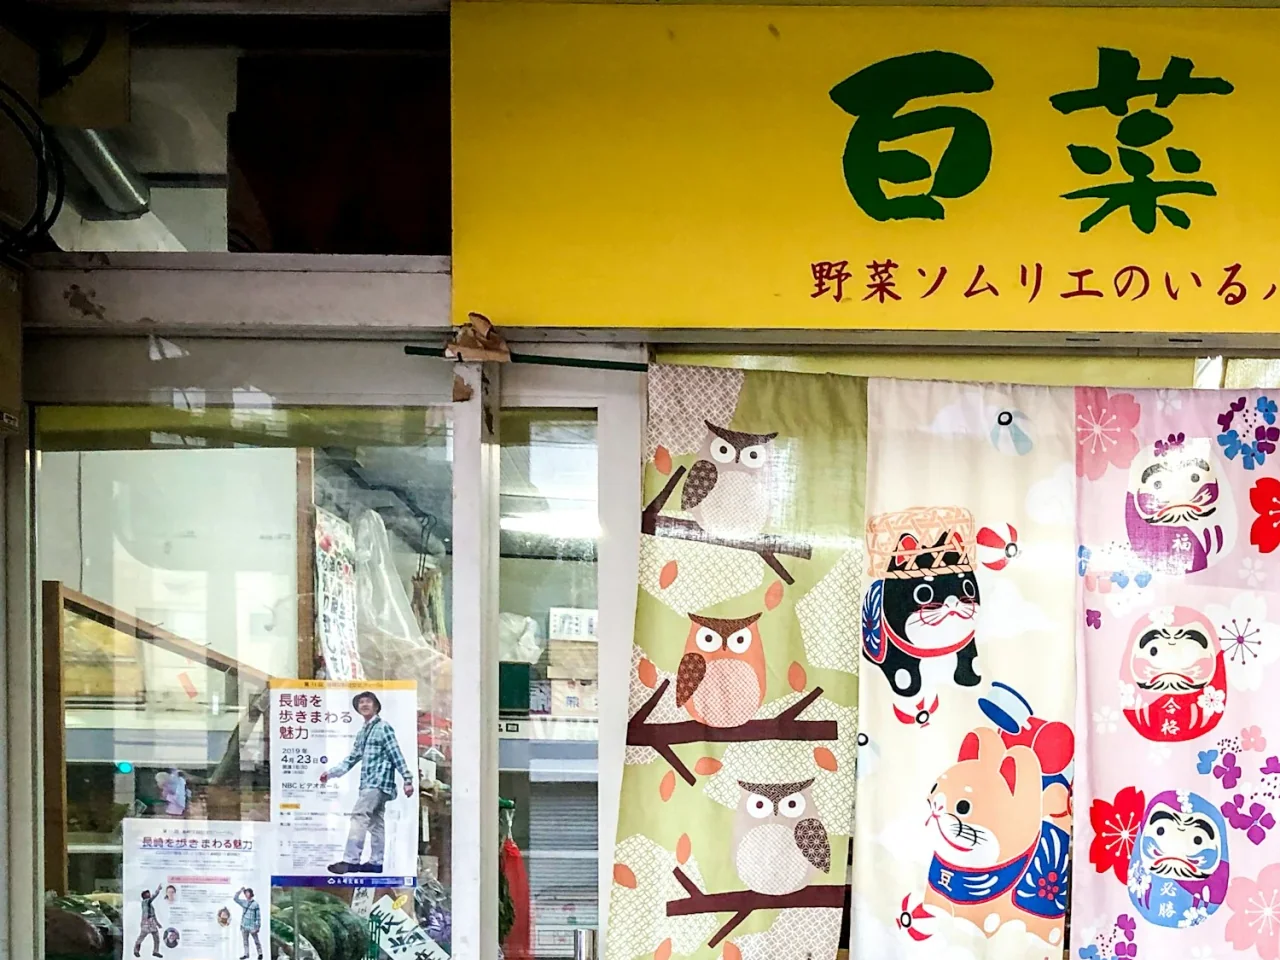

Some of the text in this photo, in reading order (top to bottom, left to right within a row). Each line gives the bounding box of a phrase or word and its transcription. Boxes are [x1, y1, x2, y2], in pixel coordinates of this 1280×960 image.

[1172, 533, 1192, 552] 福
[279, 694, 322, 707] 長崎を
[279, 710, 352, 723] 歩きまわる
[1161, 697, 1181, 735] 合格
[279, 726, 308, 740] 魅力
[142, 836, 253, 849] 長崎を歩きまわる魅力
[938, 869, 952, 886] 豆
[1158, 882, 1178, 918] 必勝
